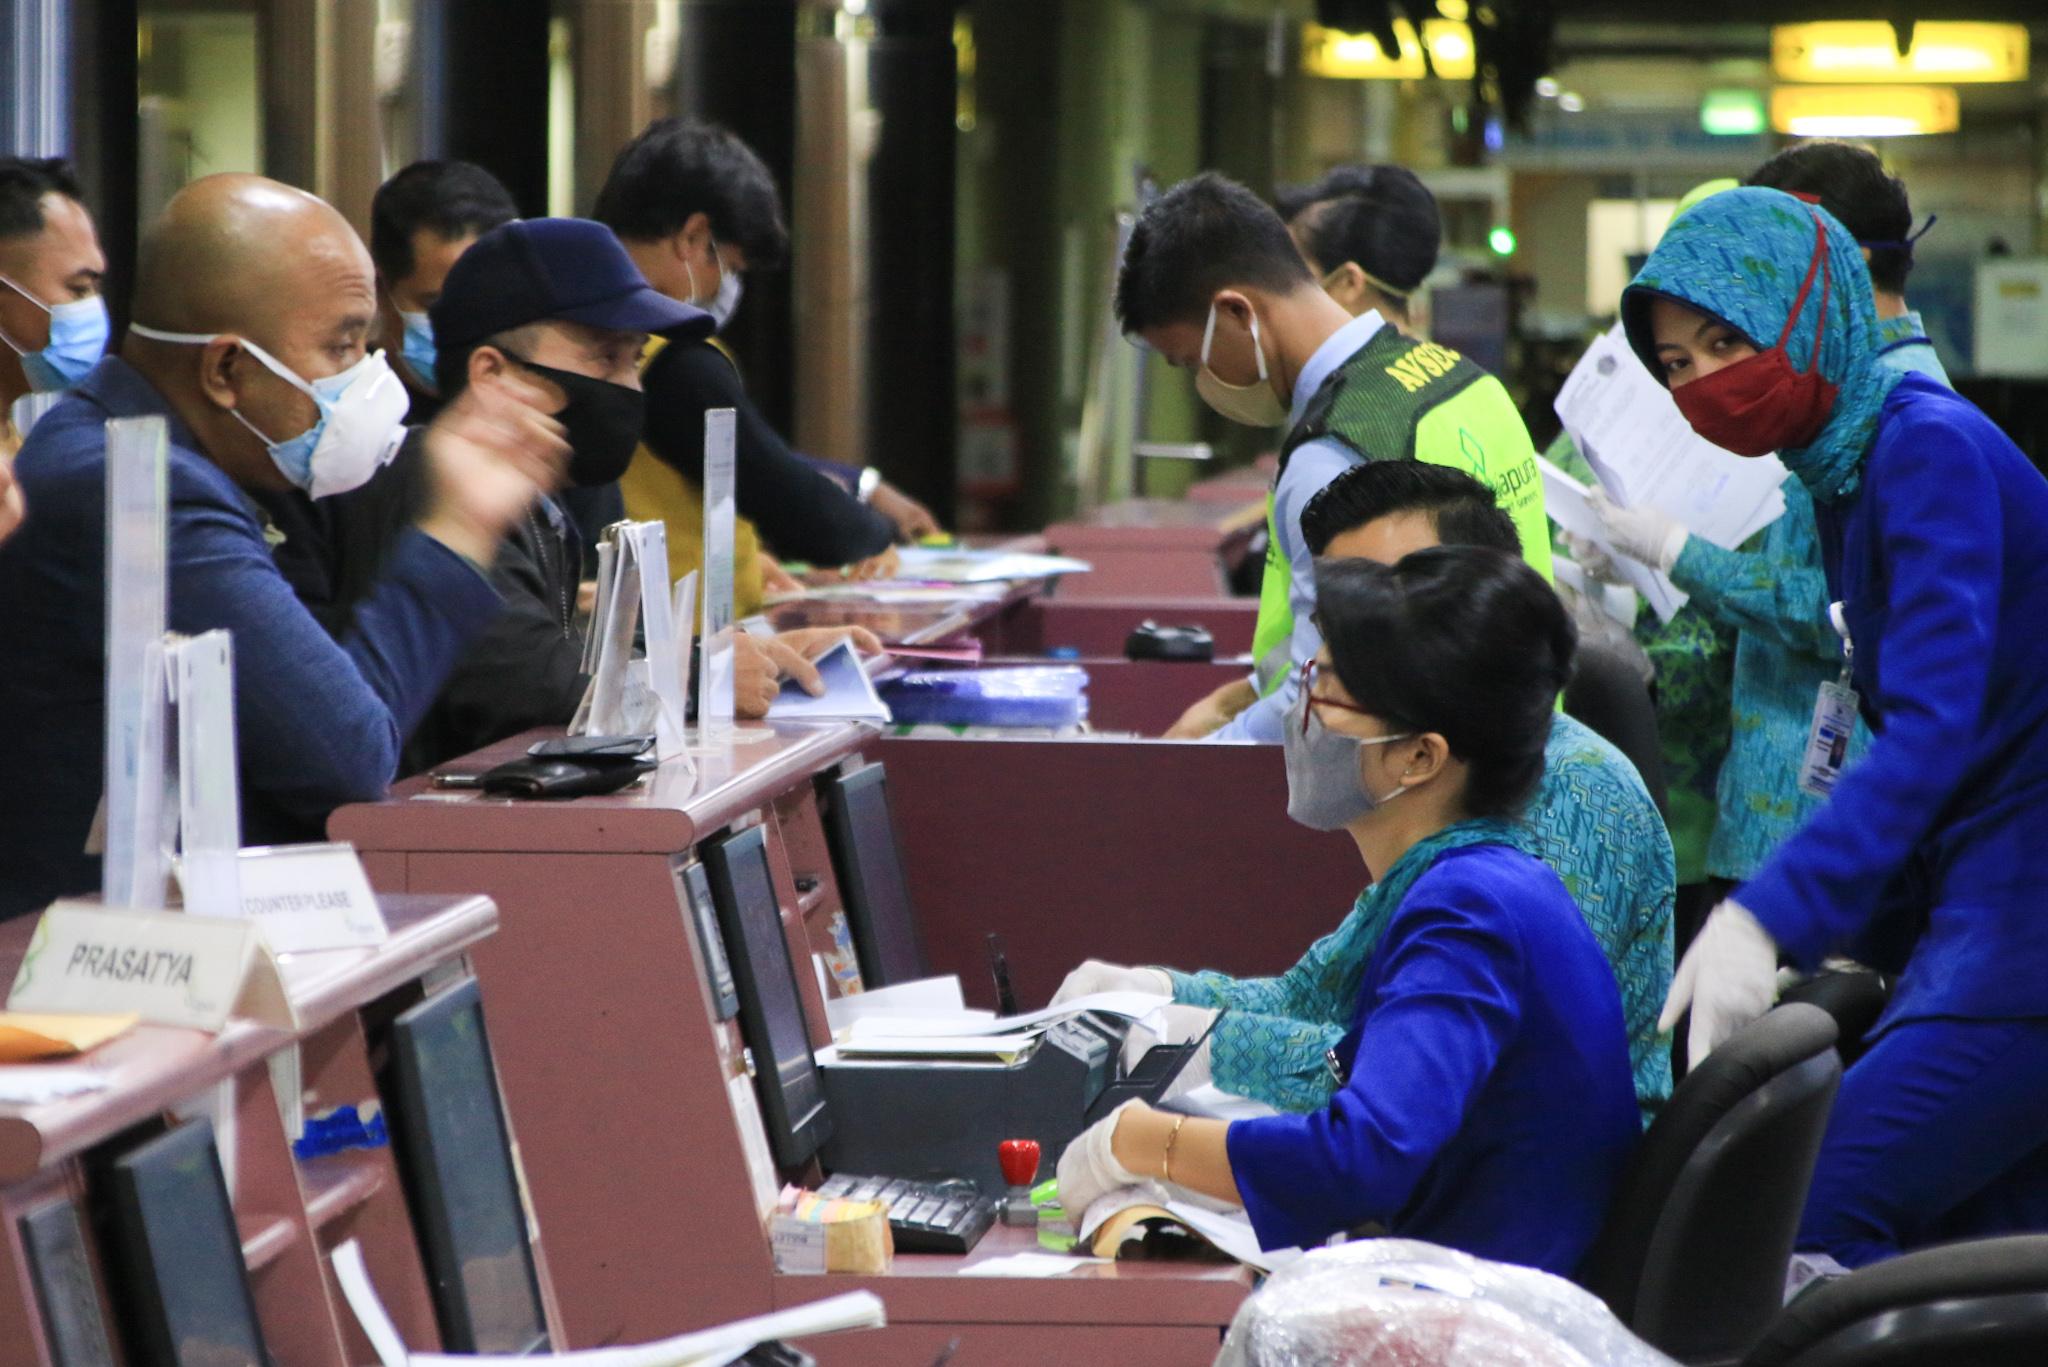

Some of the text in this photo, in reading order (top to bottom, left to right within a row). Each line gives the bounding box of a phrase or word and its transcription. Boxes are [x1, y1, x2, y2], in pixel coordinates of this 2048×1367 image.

[1384, 342, 1462, 393] AVSEC
[245, 893, 302, 915] COUNTER
[303, 890, 352, 910] PLEASE
[66, 943, 193, 986] PRASATYA
